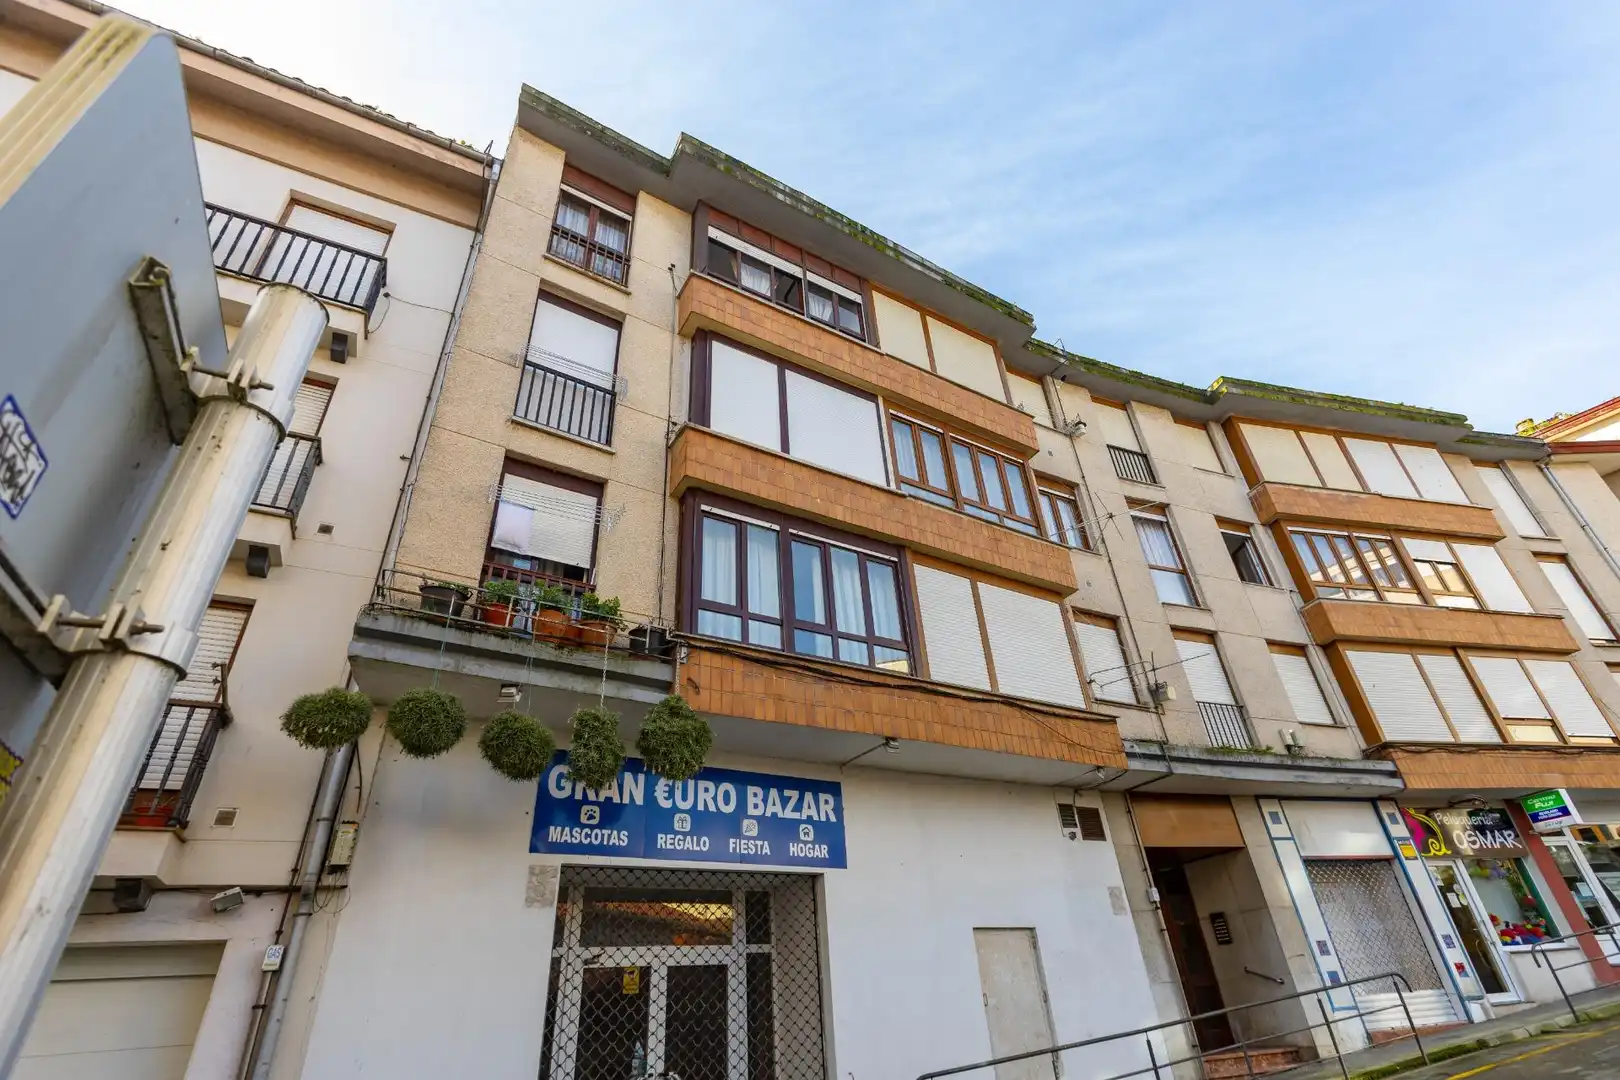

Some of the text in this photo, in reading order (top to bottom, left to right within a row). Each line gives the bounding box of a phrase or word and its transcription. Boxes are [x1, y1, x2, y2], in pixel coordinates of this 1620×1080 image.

[654, 776, 736, 814] €URO
[747, 785, 837, 822] BAZAR
[548, 826, 829, 859] MASCOTAS REGALO FIESTA HOGAR
[1452, 829, 1522, 849] OSMAR
[267, 947, 281, 959] GAS
